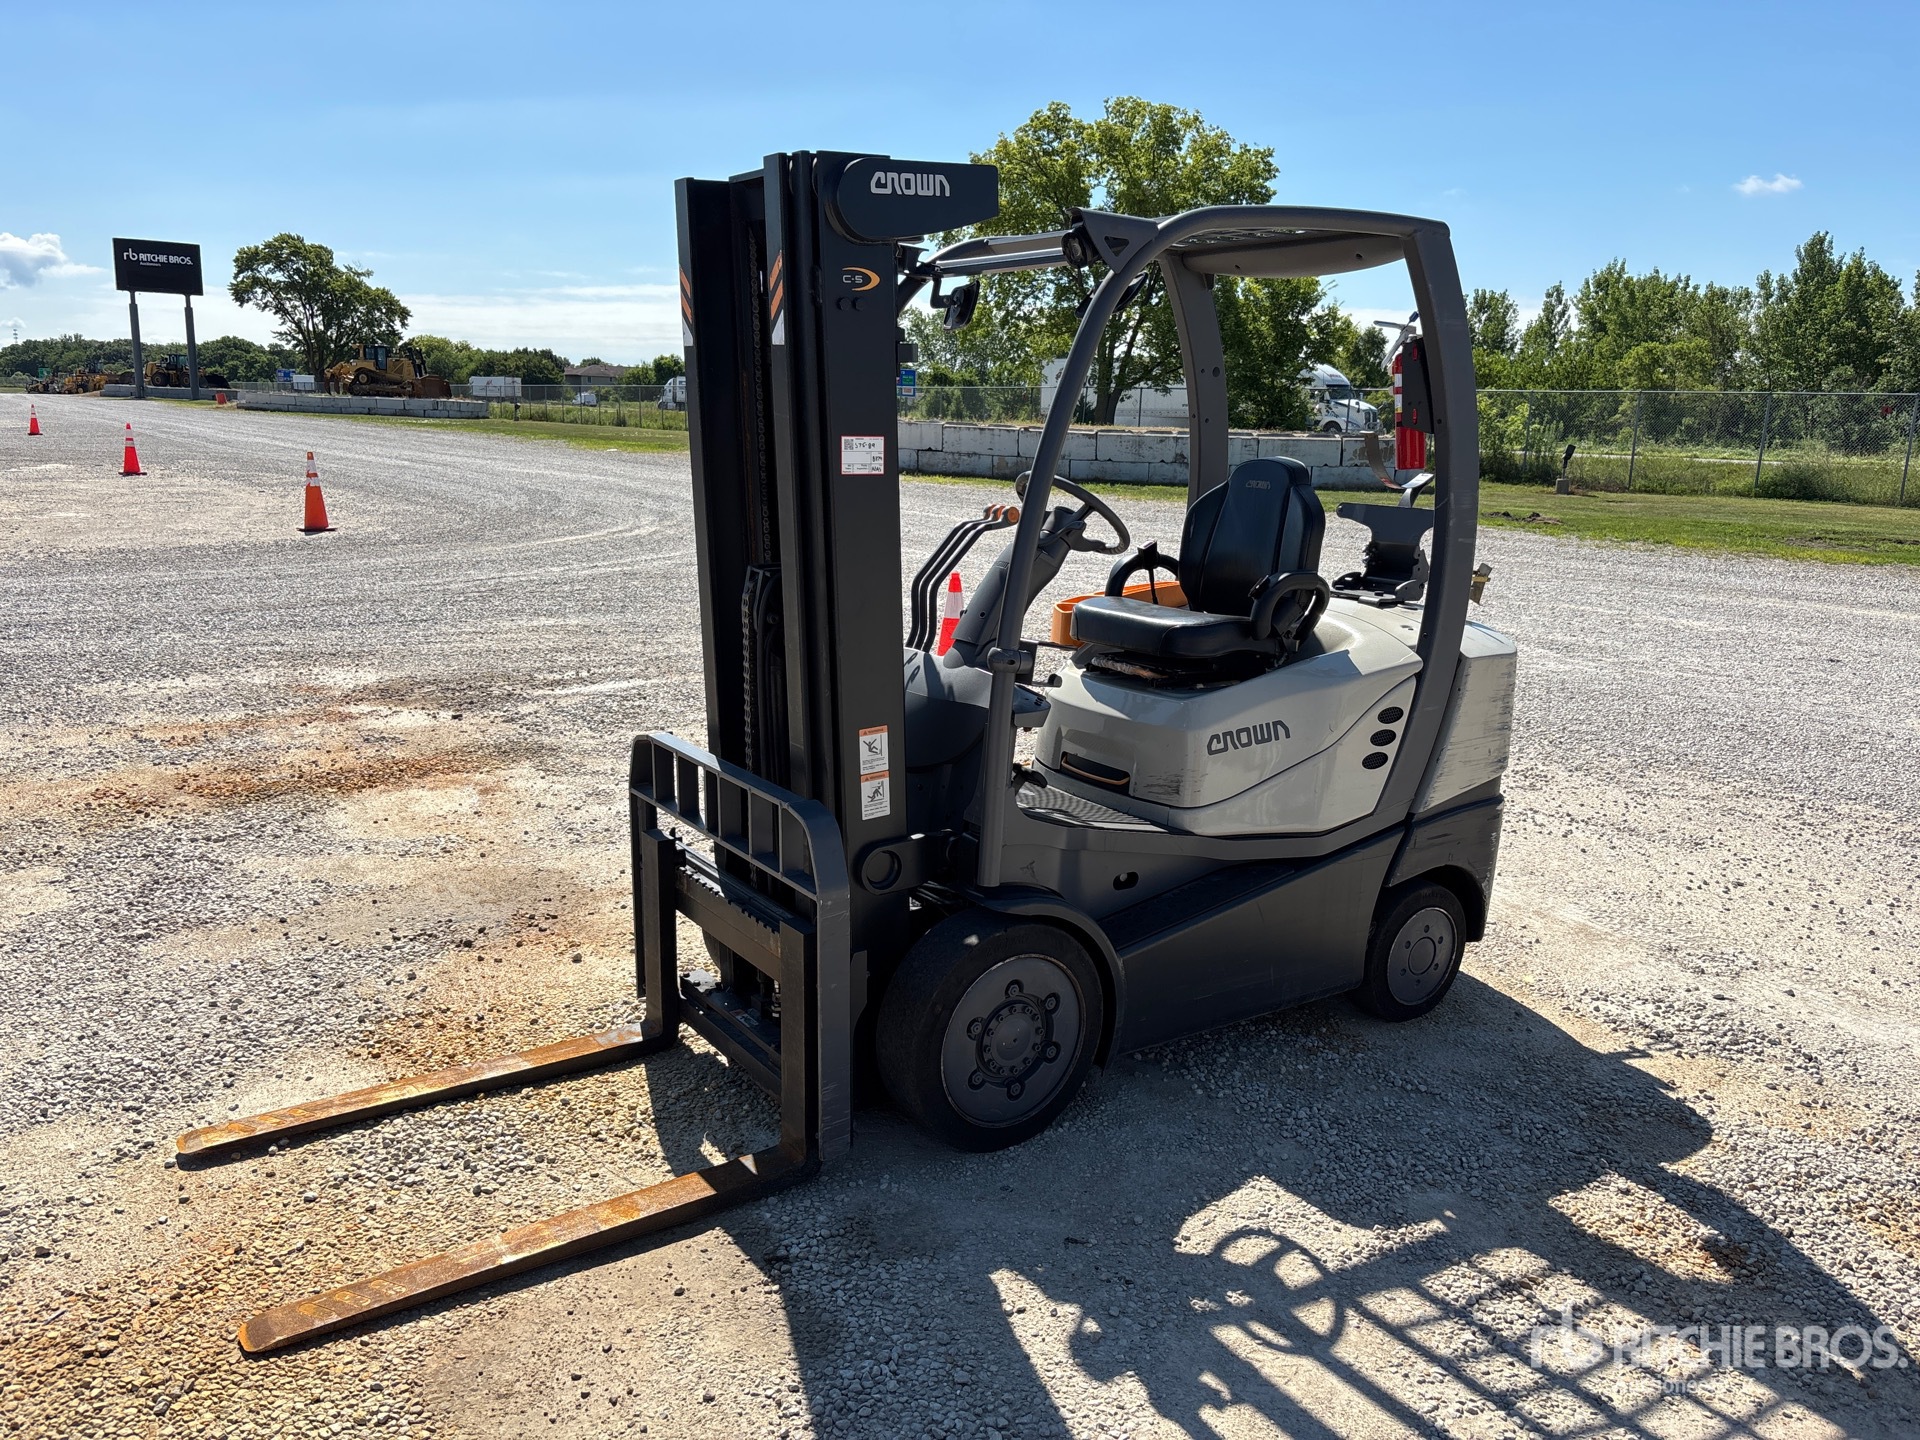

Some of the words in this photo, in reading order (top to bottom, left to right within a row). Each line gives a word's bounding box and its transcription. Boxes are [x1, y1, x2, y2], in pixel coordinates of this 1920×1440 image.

[870, 171, 950, 197] CROWN
[139, 253, 167, 263] RITCHIE
[169, 255, 193, 265] BROS.
[1245, 479, 1271, 490] CROWN
[1206, 719, 1291, 756] CROWN
